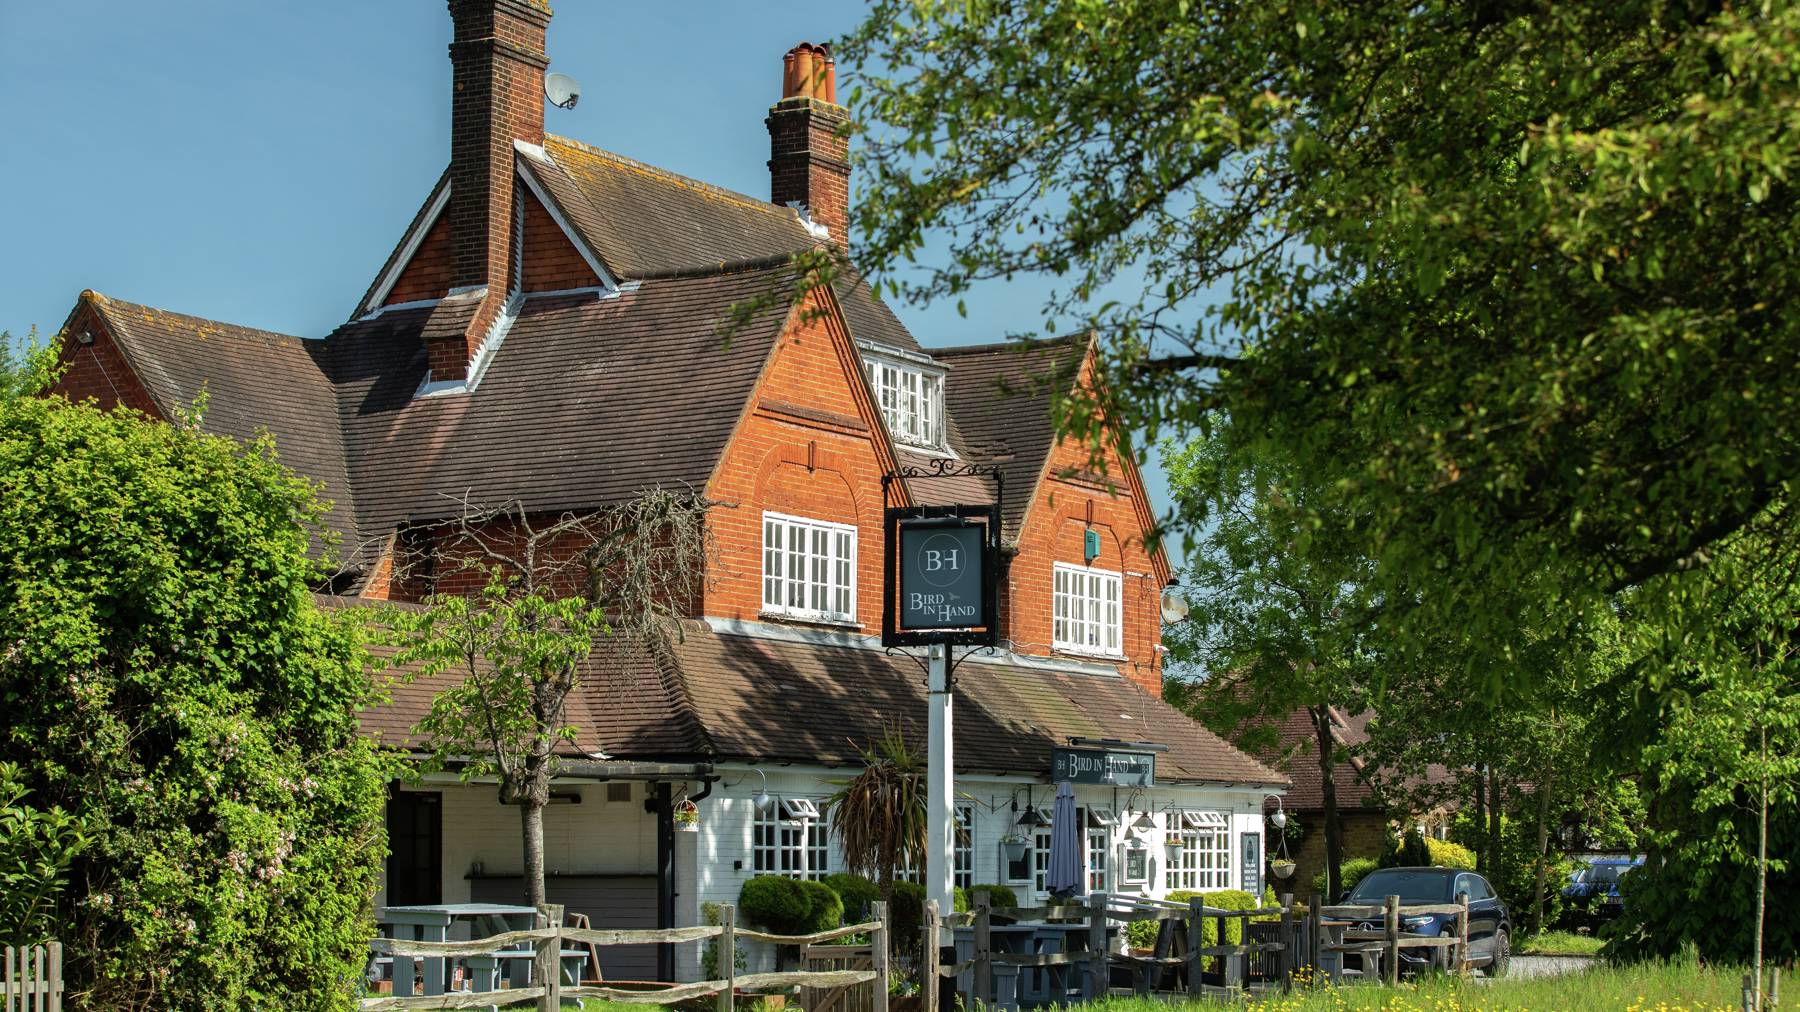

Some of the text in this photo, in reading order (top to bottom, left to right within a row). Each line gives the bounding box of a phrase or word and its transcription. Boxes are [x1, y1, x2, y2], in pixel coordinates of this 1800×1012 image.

[926, 549, 959, 571] BH
[910, 593, 945, 610] BIRD
[923, 604, 975, 622] IN HAND
[1068, 753, 1129, 779] BIRD IN HAND
